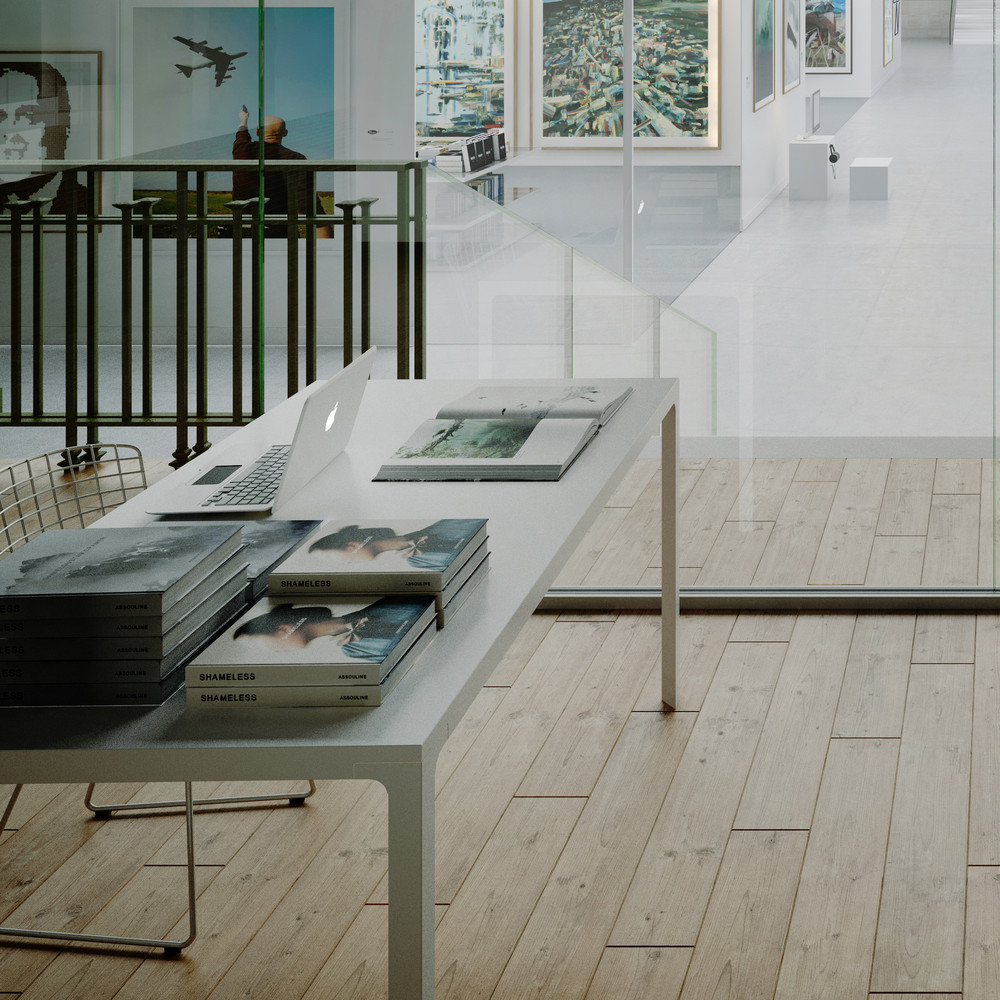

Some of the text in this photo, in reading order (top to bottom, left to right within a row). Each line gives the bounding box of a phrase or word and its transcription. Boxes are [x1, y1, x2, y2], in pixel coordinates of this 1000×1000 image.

[280, 580, 332, 588] SHAMELESS
[199, 672, 257, 682] SHAMELESS
[200, 692, 258, 703] SHAMELESS
